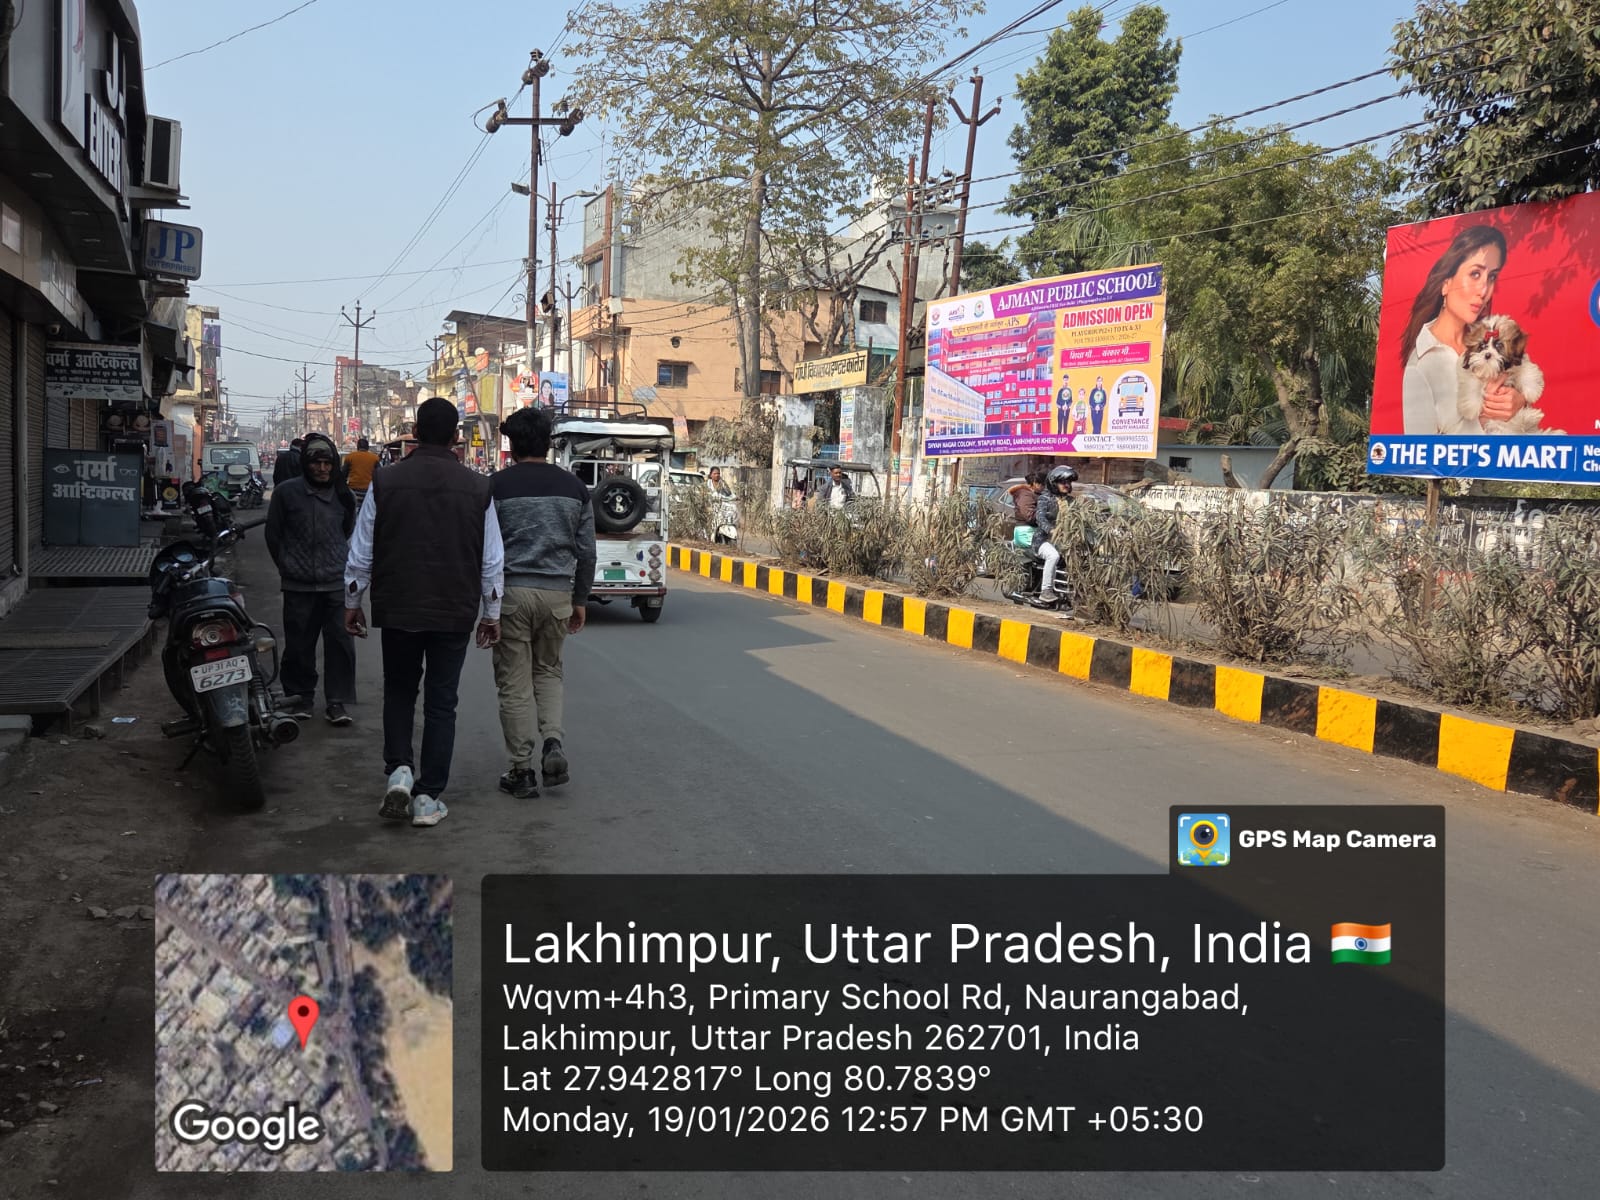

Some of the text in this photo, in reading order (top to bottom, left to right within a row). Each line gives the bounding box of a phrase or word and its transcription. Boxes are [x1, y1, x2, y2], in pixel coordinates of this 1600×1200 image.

[150, 228, 195, 263] JP
[997, 288, 1045, 311] AJMANI
[1047, 280, 1096, 304] PUBLIC
[1096, 271, 1158, 296] SCHOOL
[1062, 303, 1153, 329] ADMISSION OPEN
[74, 455, 117, 482] वर्मा
[1389, 443, 1573, 469] THE PET'S MART
[1582, 459, 1600, 472] Ch
[200, 668, 246, 689] 6273
